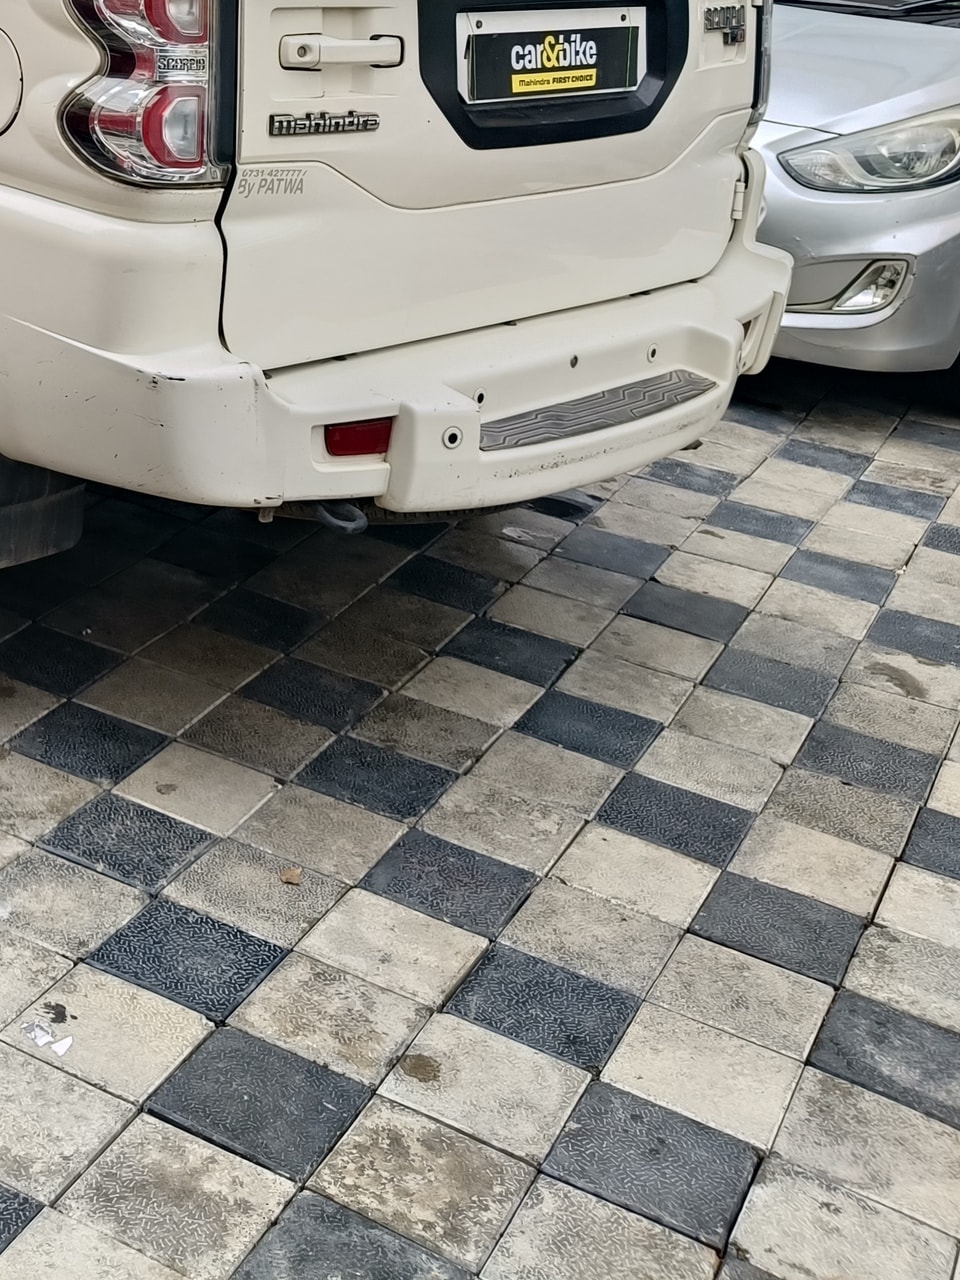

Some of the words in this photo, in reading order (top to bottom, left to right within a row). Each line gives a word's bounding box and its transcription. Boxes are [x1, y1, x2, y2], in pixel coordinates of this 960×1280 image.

[510, 33, 598, 71] car&bike
[157, 57, 206, 73] SCORPIO
[551, 76, 571, 84] FIRST
[571, 74, 594, 83] CHOICE
[238, 178, 255, 199] By
[256, 178, 304, 195] PATWA
